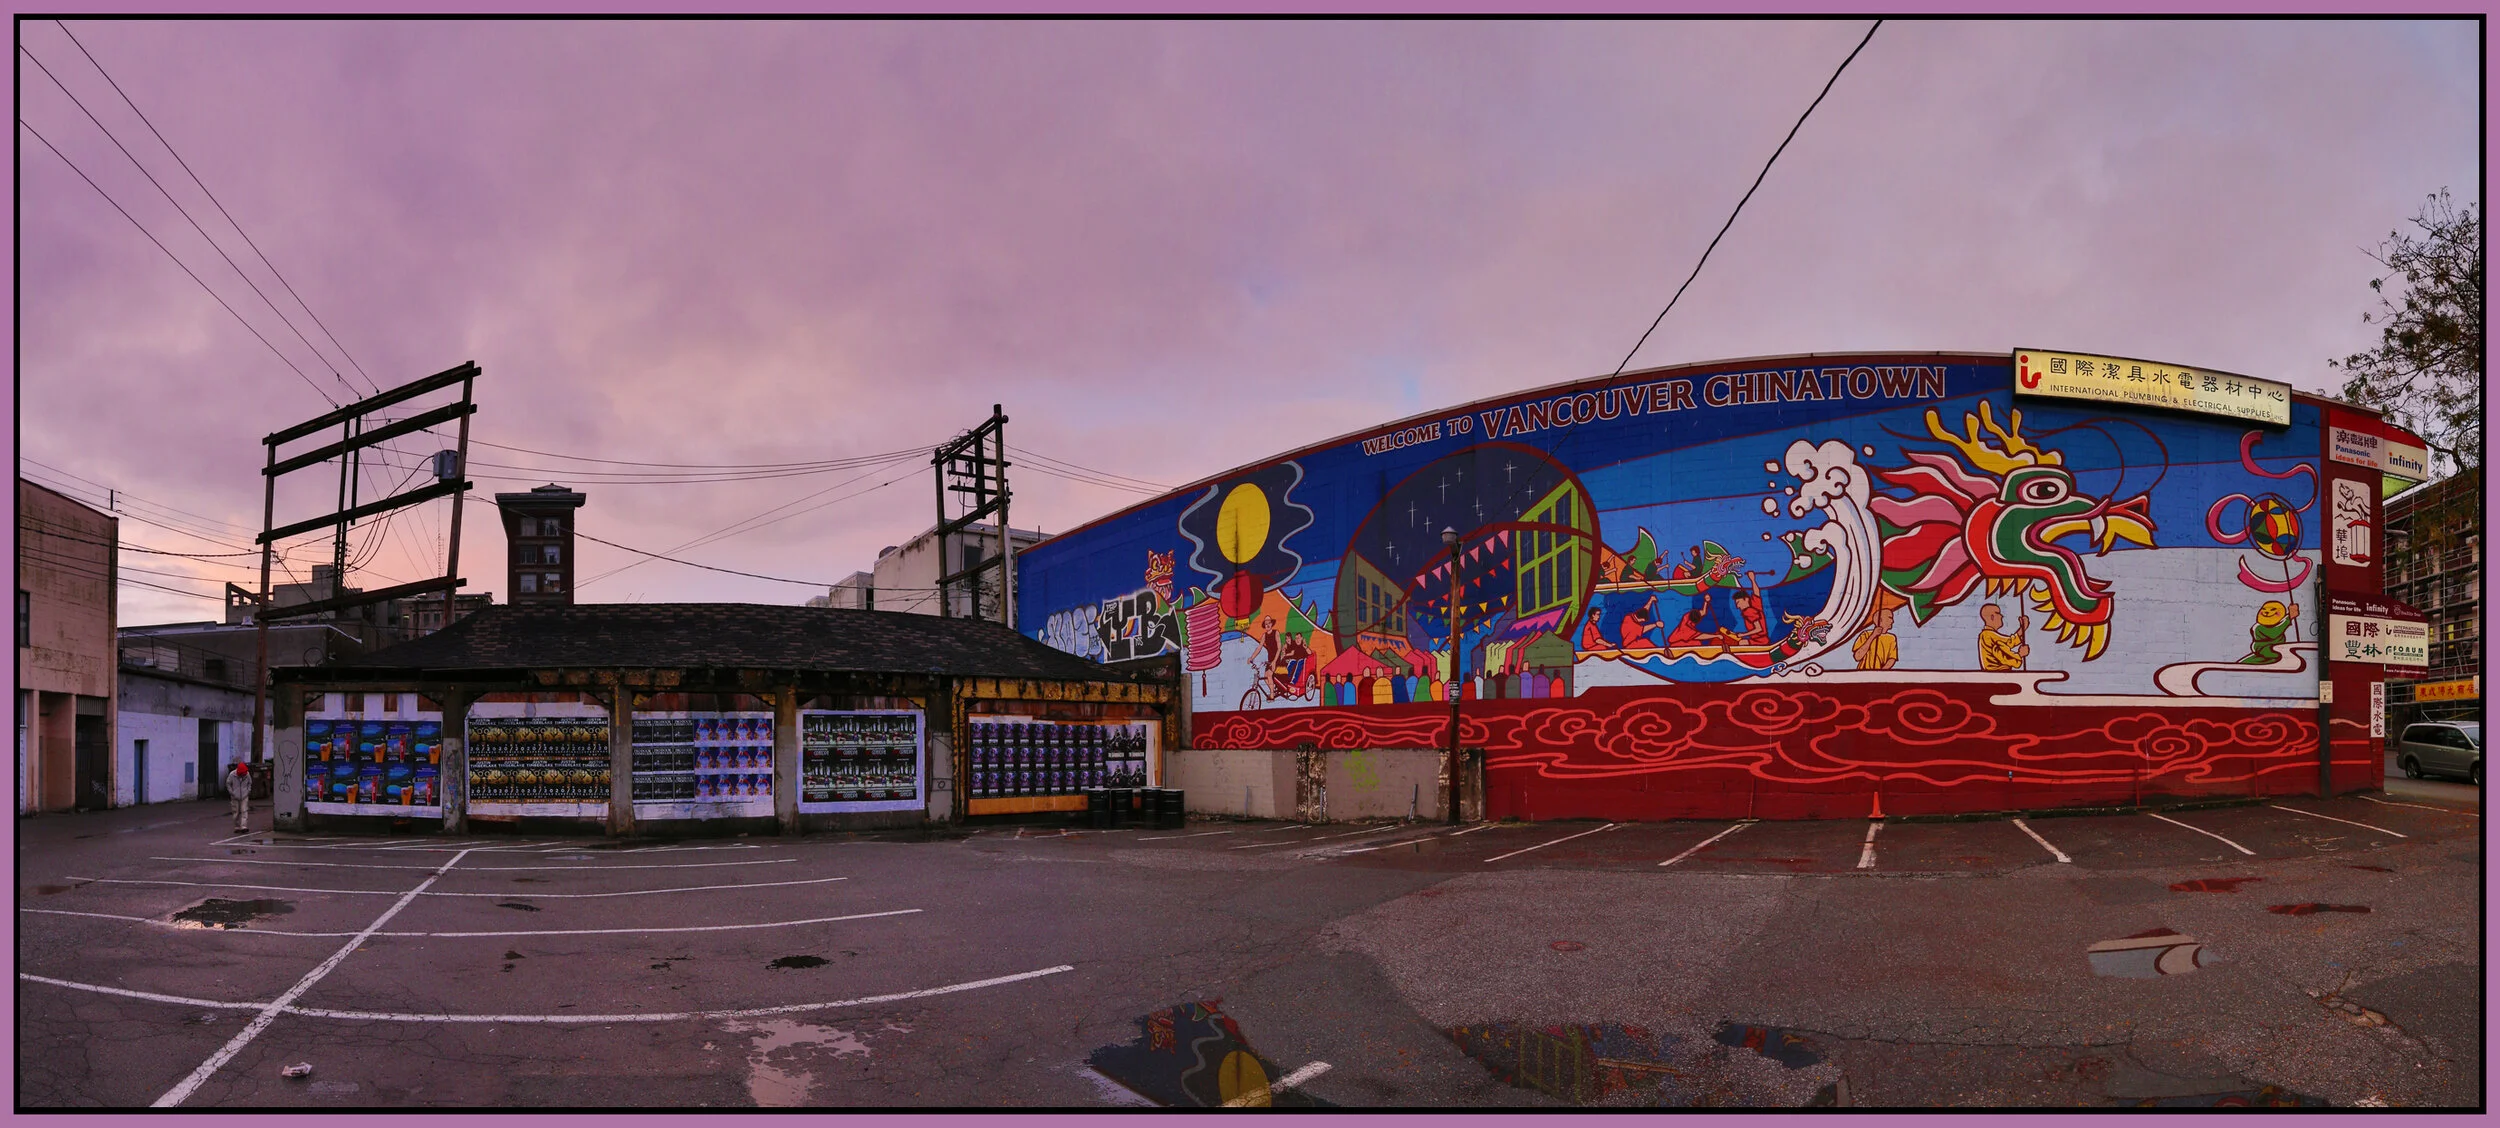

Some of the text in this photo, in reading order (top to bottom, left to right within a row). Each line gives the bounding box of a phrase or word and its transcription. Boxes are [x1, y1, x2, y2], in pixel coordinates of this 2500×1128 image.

[2050, 357, 2285, 402] 國際潔具水電器材中心
[2050, 385, 2119, 397] INTERNATIONAL
[2123, 391, 2168, 403] PLUMBING
[2183, 398, 2232, 412] ELECTRICAL
[2236, 406, 2271, 418] SUPPLIES
[1362, 366, 1946, 456] WELCOME TO VANCOUVER CHINATOWN
[2335, 444, 2371, 458] Panasonic
[2335, 453, 2355, 463] ideas
[2356, 457, 2365, 465] for
[2388, 451, 2423, 473] infinity
[2332, 598, 2357, 606] Panasonic
[2366, 602, 2389, 615] infinity
[2346, 621, 2380, 638] 國際
[2344, 640, 2383, 660] 豐林
[2393, 645, 2424, 654] FORUM
[2372, 684, 2383, 736] 國際水電
